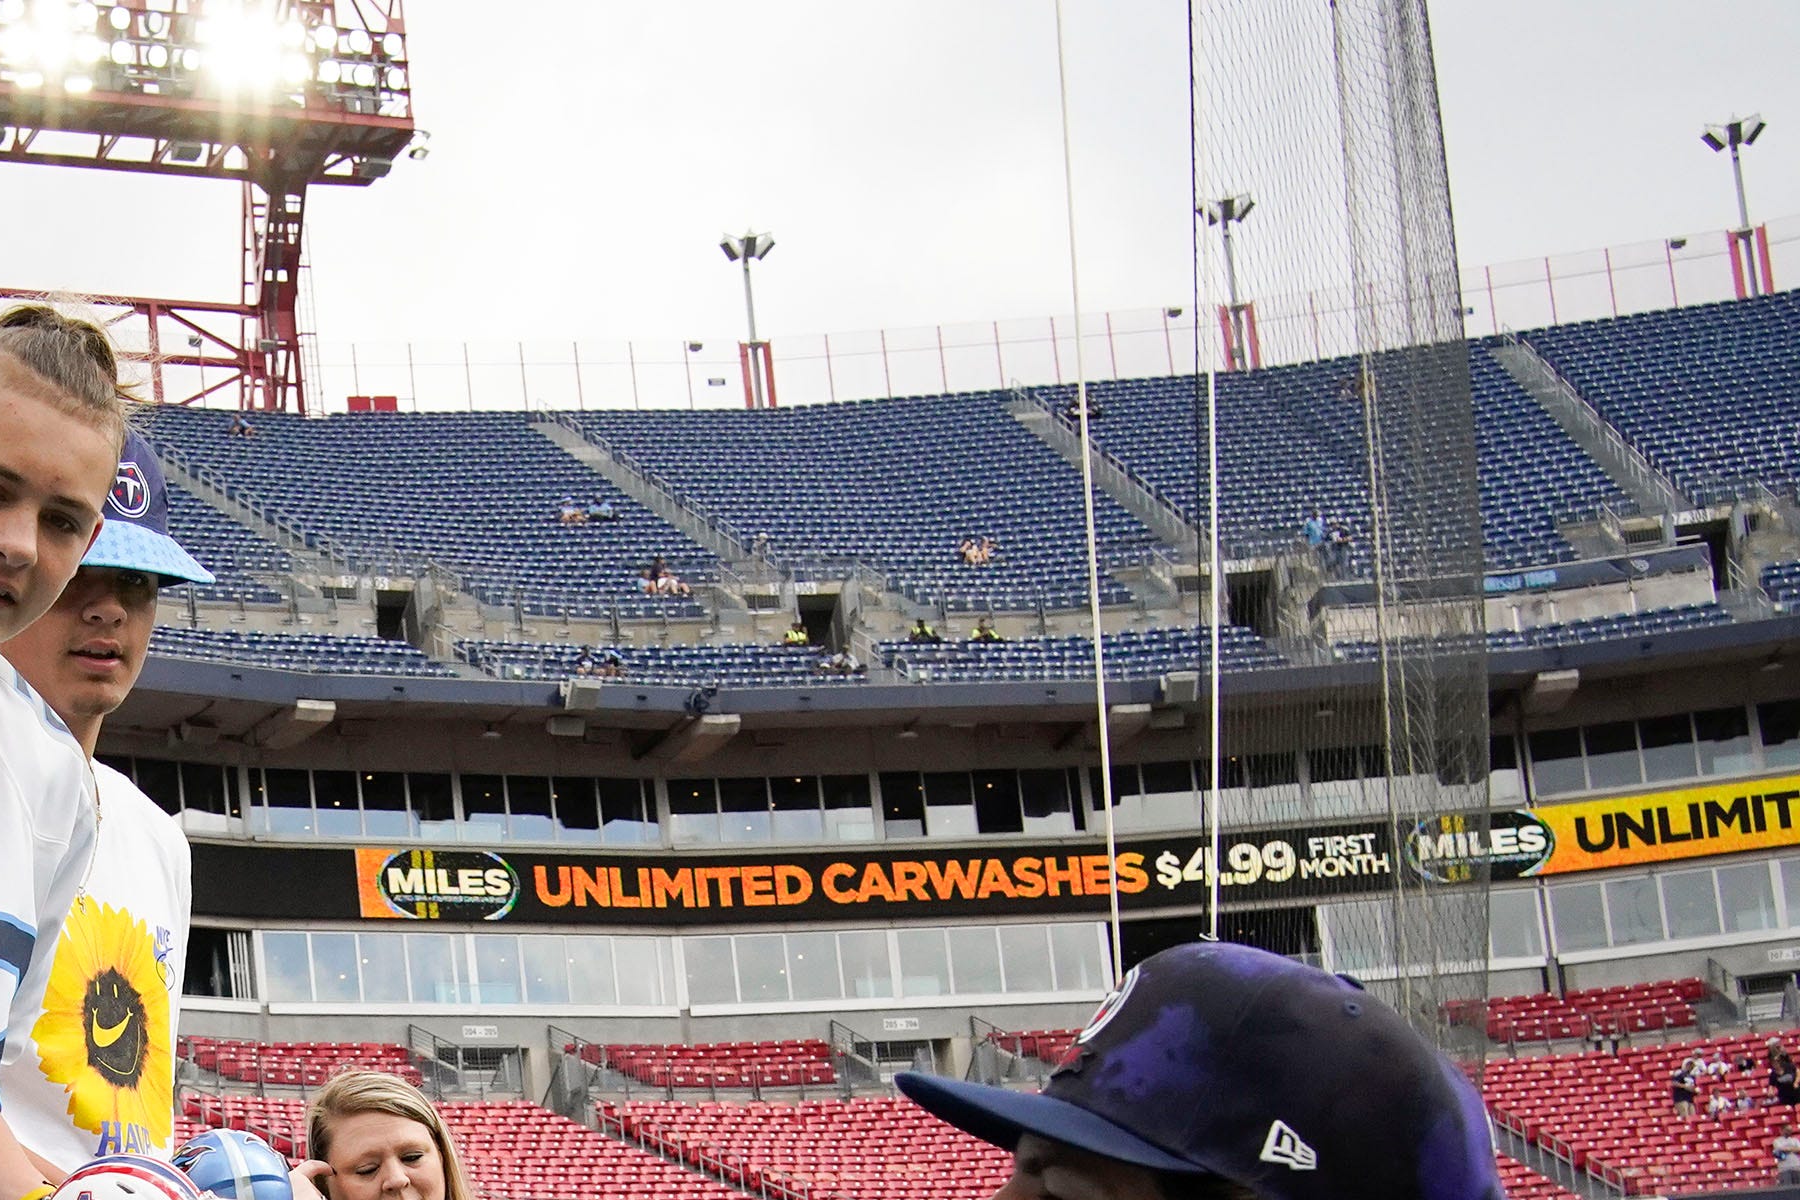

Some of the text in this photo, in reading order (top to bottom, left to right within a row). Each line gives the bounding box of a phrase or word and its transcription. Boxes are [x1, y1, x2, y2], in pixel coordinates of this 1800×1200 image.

[1575, 790, 1800, 854] UNLIMIT
[1308, 833, 1376, 859] FIRST
[1417, 824, 1547, 861] MILES
[387, 867, 512, 896] MILES
[533, 838, 1297, 908] UNLIMITED CARWASHES $4.99
[1300, 852, 1391, 880] MONTH
